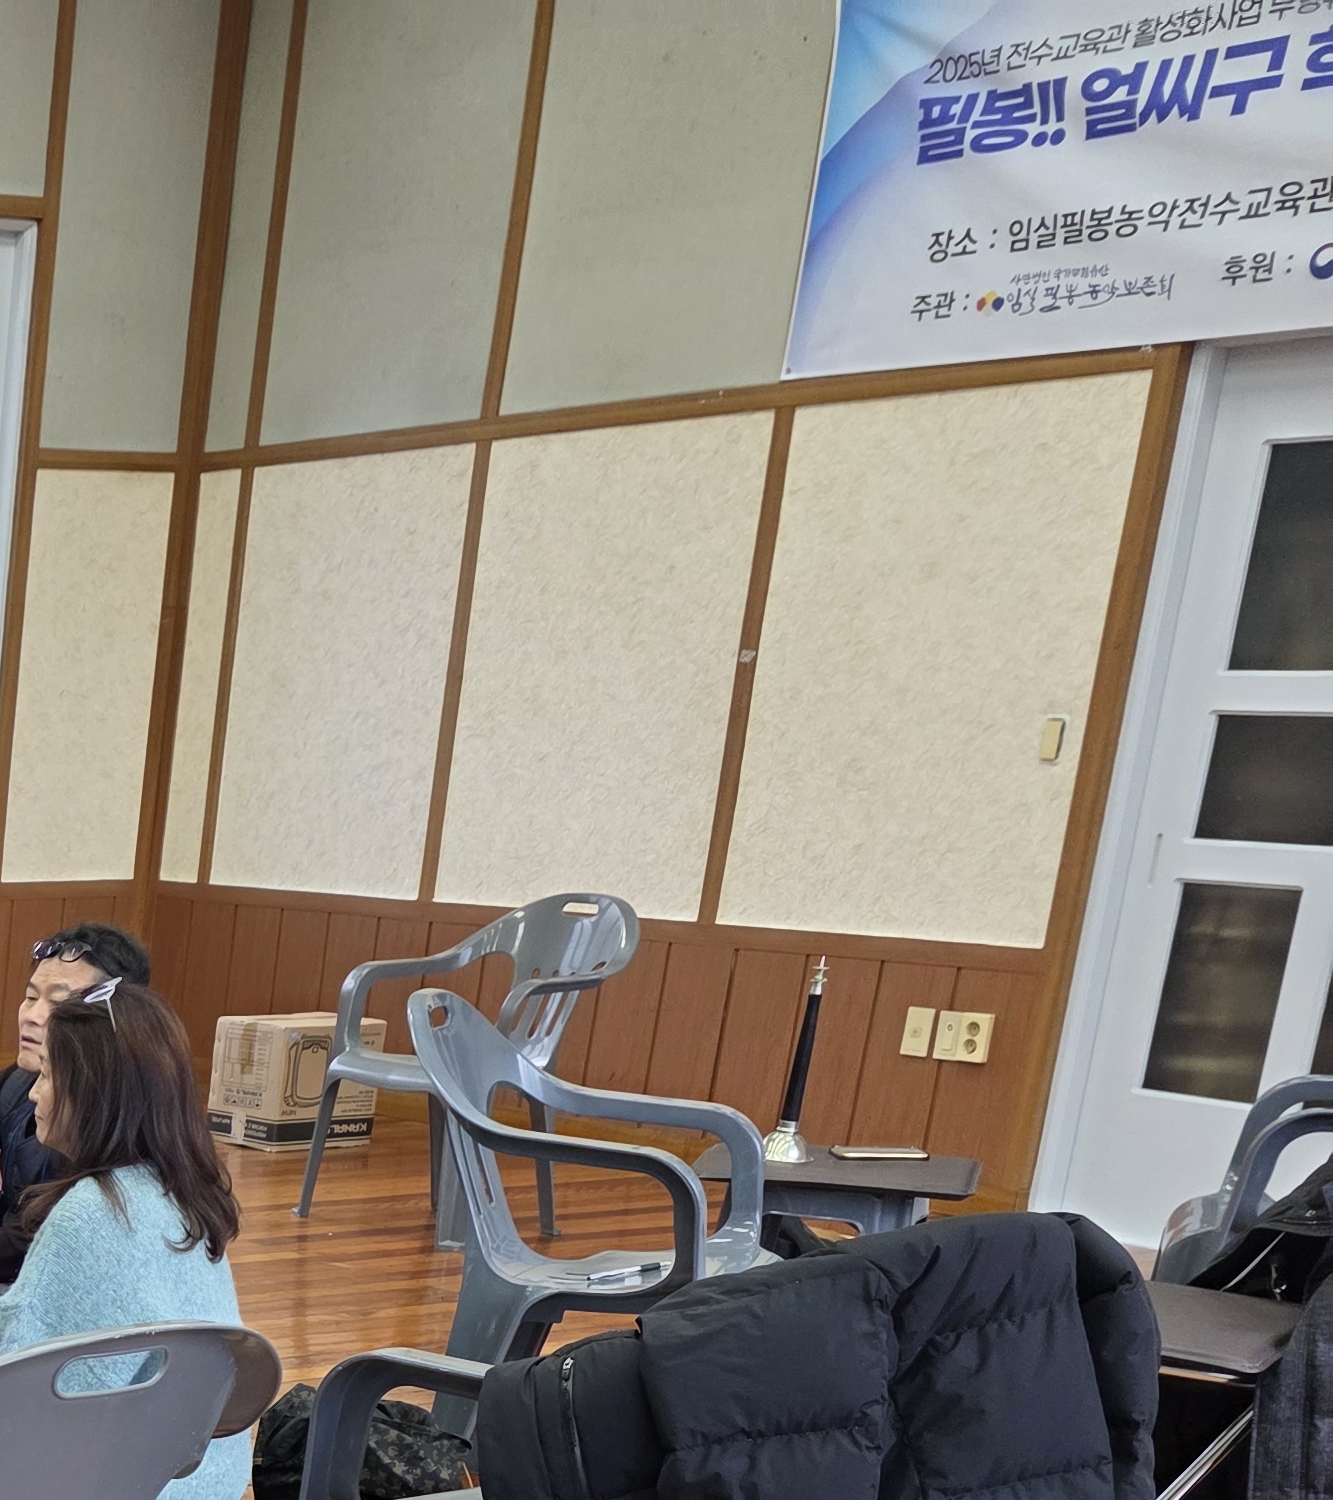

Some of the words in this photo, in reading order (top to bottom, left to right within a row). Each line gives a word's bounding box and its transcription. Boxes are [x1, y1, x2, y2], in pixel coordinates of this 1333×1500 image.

[923, 45, 1004, 86] 2025년
[1005, 23, 1133, 72] 전수교육관
[1133, 0, 1263, 49] 활성화사업
[917, 76, 1068, 166] 필봉!!
[1080, 34, 1292, 142] 얼씨구
[926, 226, 979, 264] 장소
[1008, 174, 1333, 254] 임실필봉농악전수교육관
[908, 290, 957, 323] 주관
[1220, 249, 1277, 288] 후원
